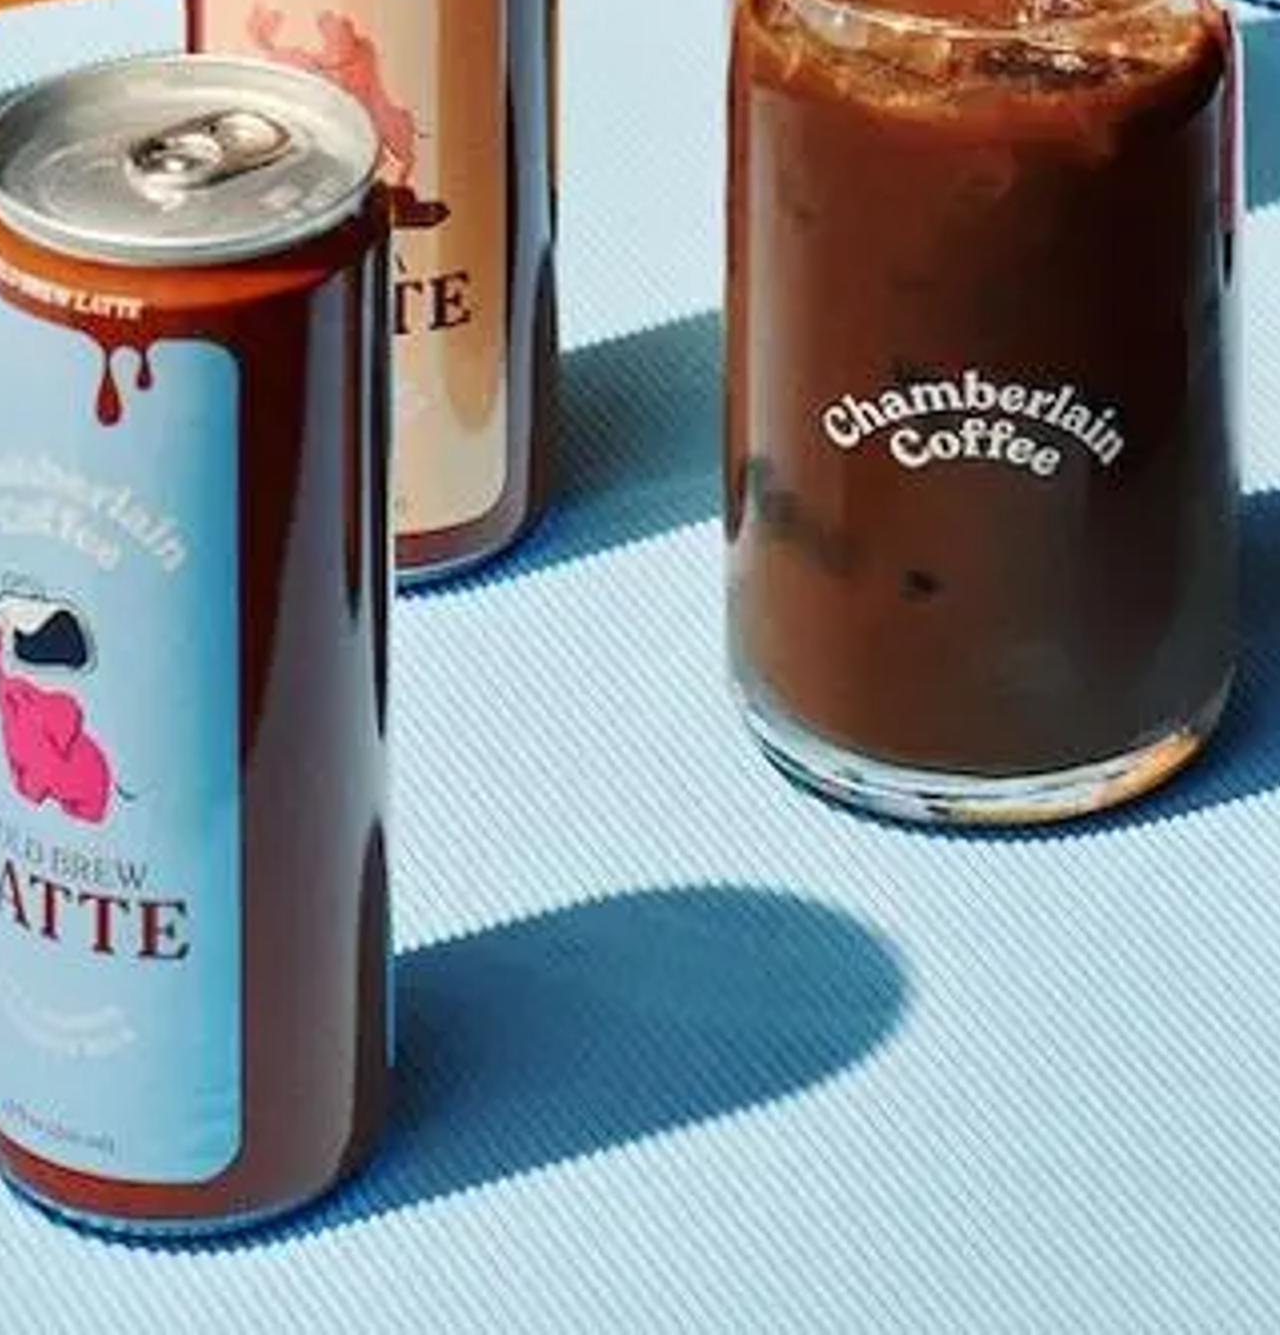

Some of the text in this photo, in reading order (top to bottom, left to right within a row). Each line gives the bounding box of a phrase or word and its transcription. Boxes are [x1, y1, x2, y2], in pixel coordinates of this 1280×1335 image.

[73, 289, 144, 320] LATTE
[822, 370, 1124, 465] Chamberlain
[889, 418, 1061, 475] Coffee
[52, 845, 148, 890] BREW
